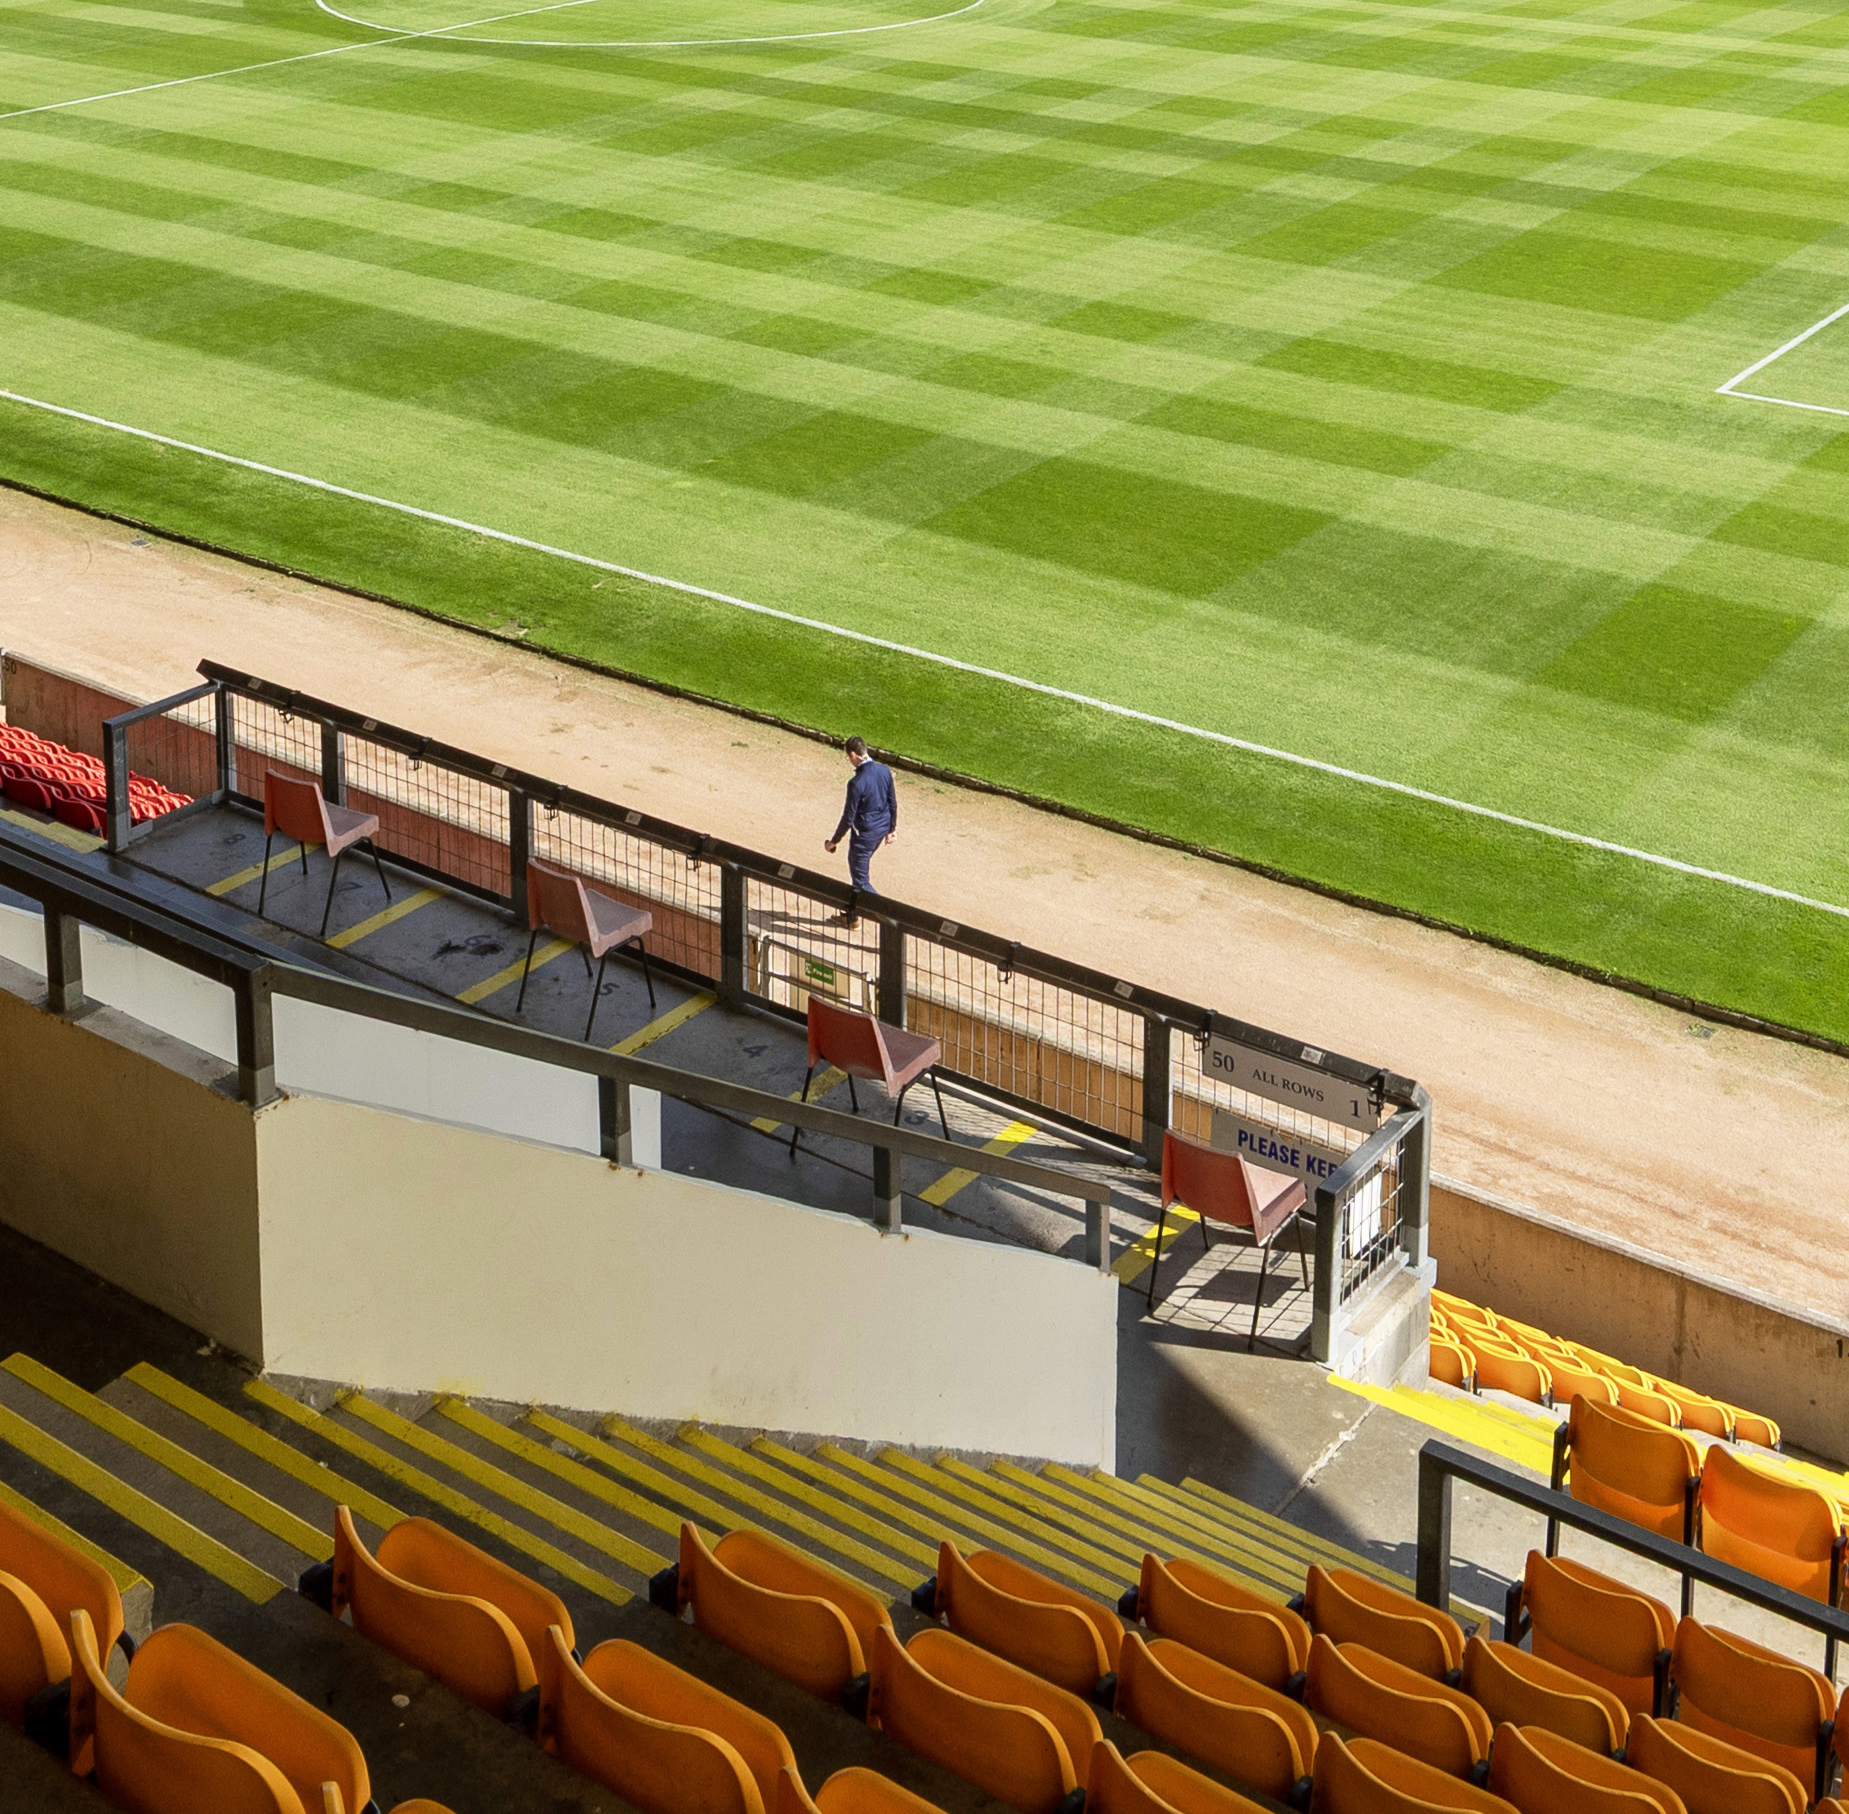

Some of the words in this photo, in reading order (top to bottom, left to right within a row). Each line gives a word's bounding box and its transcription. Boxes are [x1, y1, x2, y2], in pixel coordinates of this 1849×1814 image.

[598, 982, 620, 995] 5
[742, 1044, 769, 1058] 4
[1211, 1050, 1234, 1073] 50
[1252, 1069, 1278, 1087] ALL
[1281, 1078, 1324, 1102] ROWS
[1238, 1129, 1301, 1168] PLEASE
